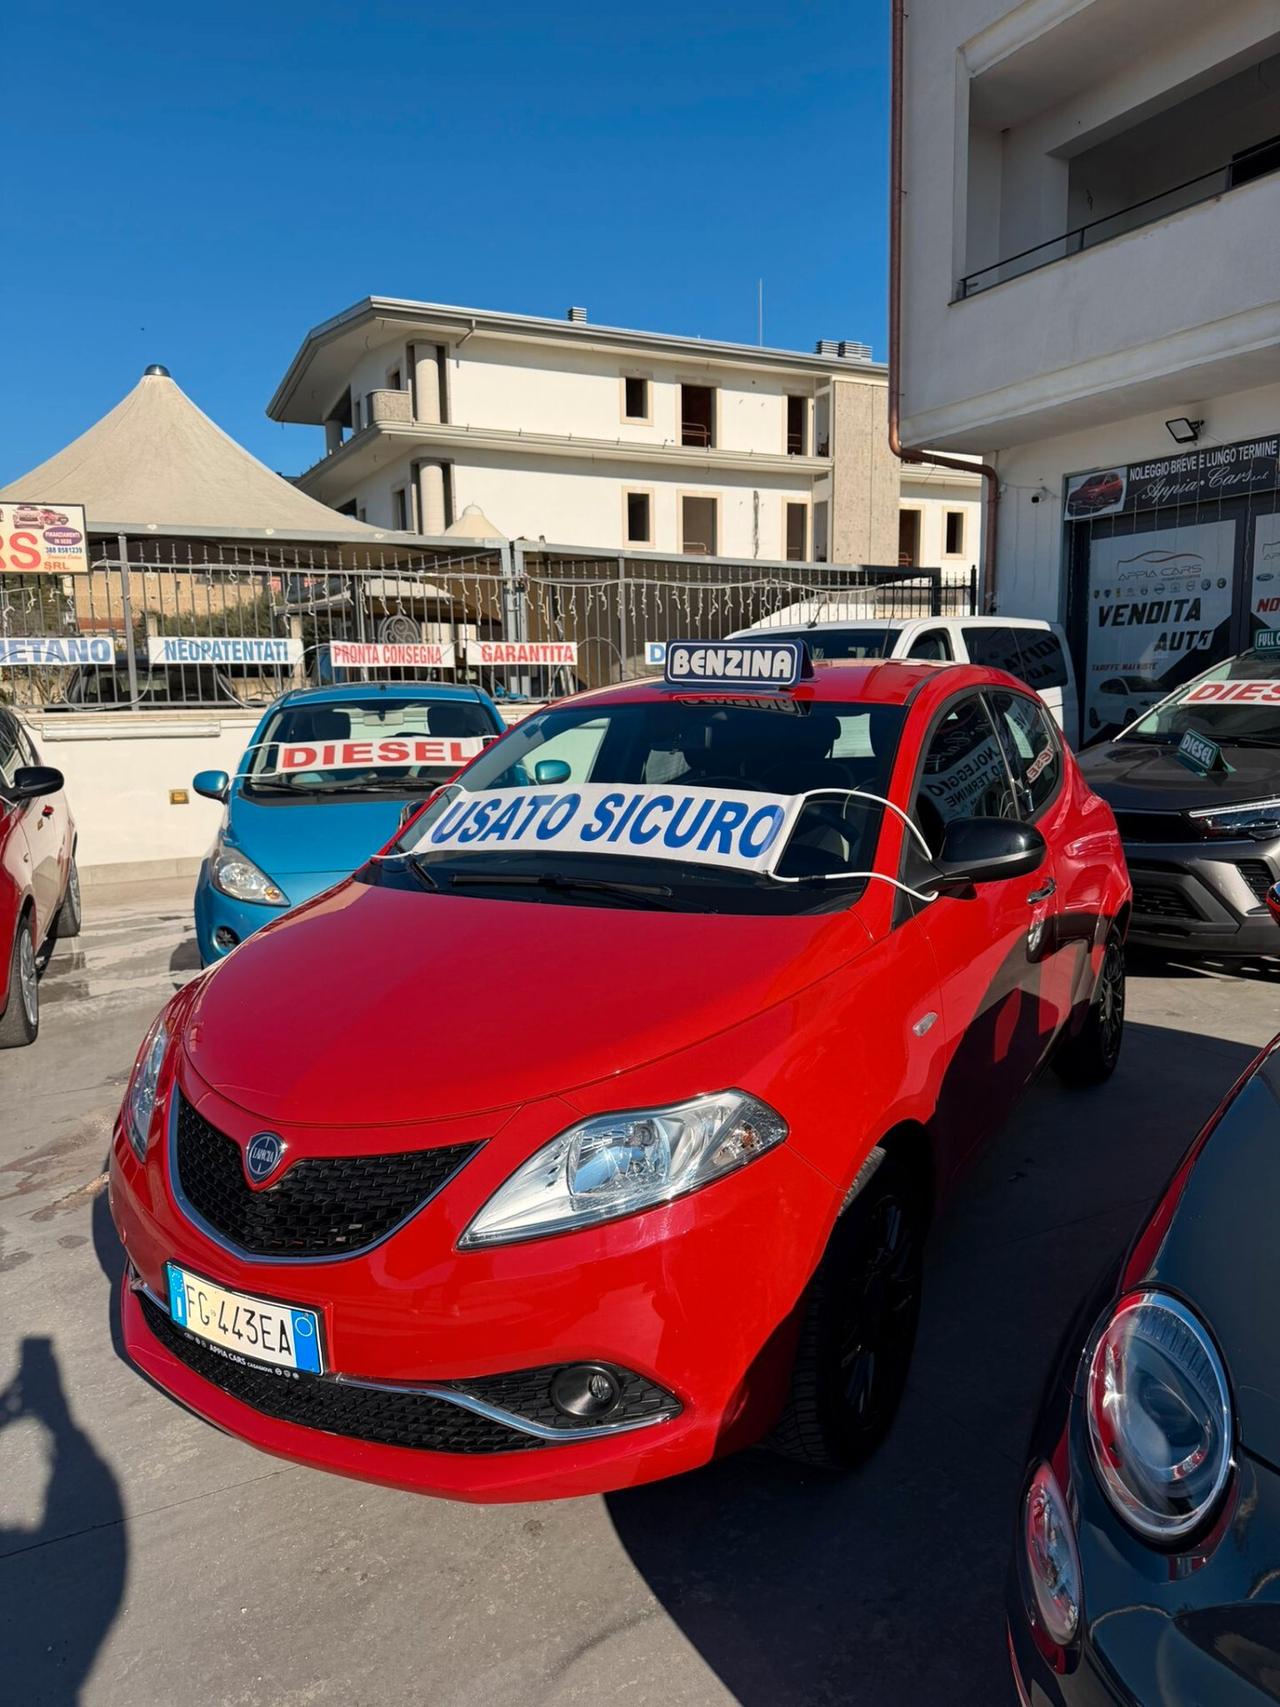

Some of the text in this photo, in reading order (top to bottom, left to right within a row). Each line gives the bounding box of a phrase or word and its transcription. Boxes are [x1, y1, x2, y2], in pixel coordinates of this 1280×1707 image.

[1130, 440, 1278, 481] NOLEGGIO BREVE E LUNGO TERMINE
[1141, 477, 1199, 503] Appia
[0, 531, 42, 569] S
[43, 560, 71, 571] SRL
[1117, 569, 1157, 582] APPIA
[1160, 564, 1202, 577] CARS
[1098, 597, 1201, 628] VENDITA
[1256, 598, 1280, 613] NO
[0, 639, 111, 663] ETANO
[164, 639, 289, 662] NEOPATENTATI
[1153, 629, 1215, 652] AUTO
[1258, 632, 1275, 647] FULL
[333, 644, 443, 665] PRONTA CONSEGNA
[481, 643, 575, 663] GARANTITA
[672, 648, 793, 679] BENZINA
[282, 740, 473, 769] DIESEL
[1180, 731, 1214, 767] DIESEL
[431, 792, 786, 859] USATO SICURO
[252, 1147, 275, 1163] LANCIA
[209, 1344, 229, 1359] APPIA
[228, 1352, 247, 1367] CARS
